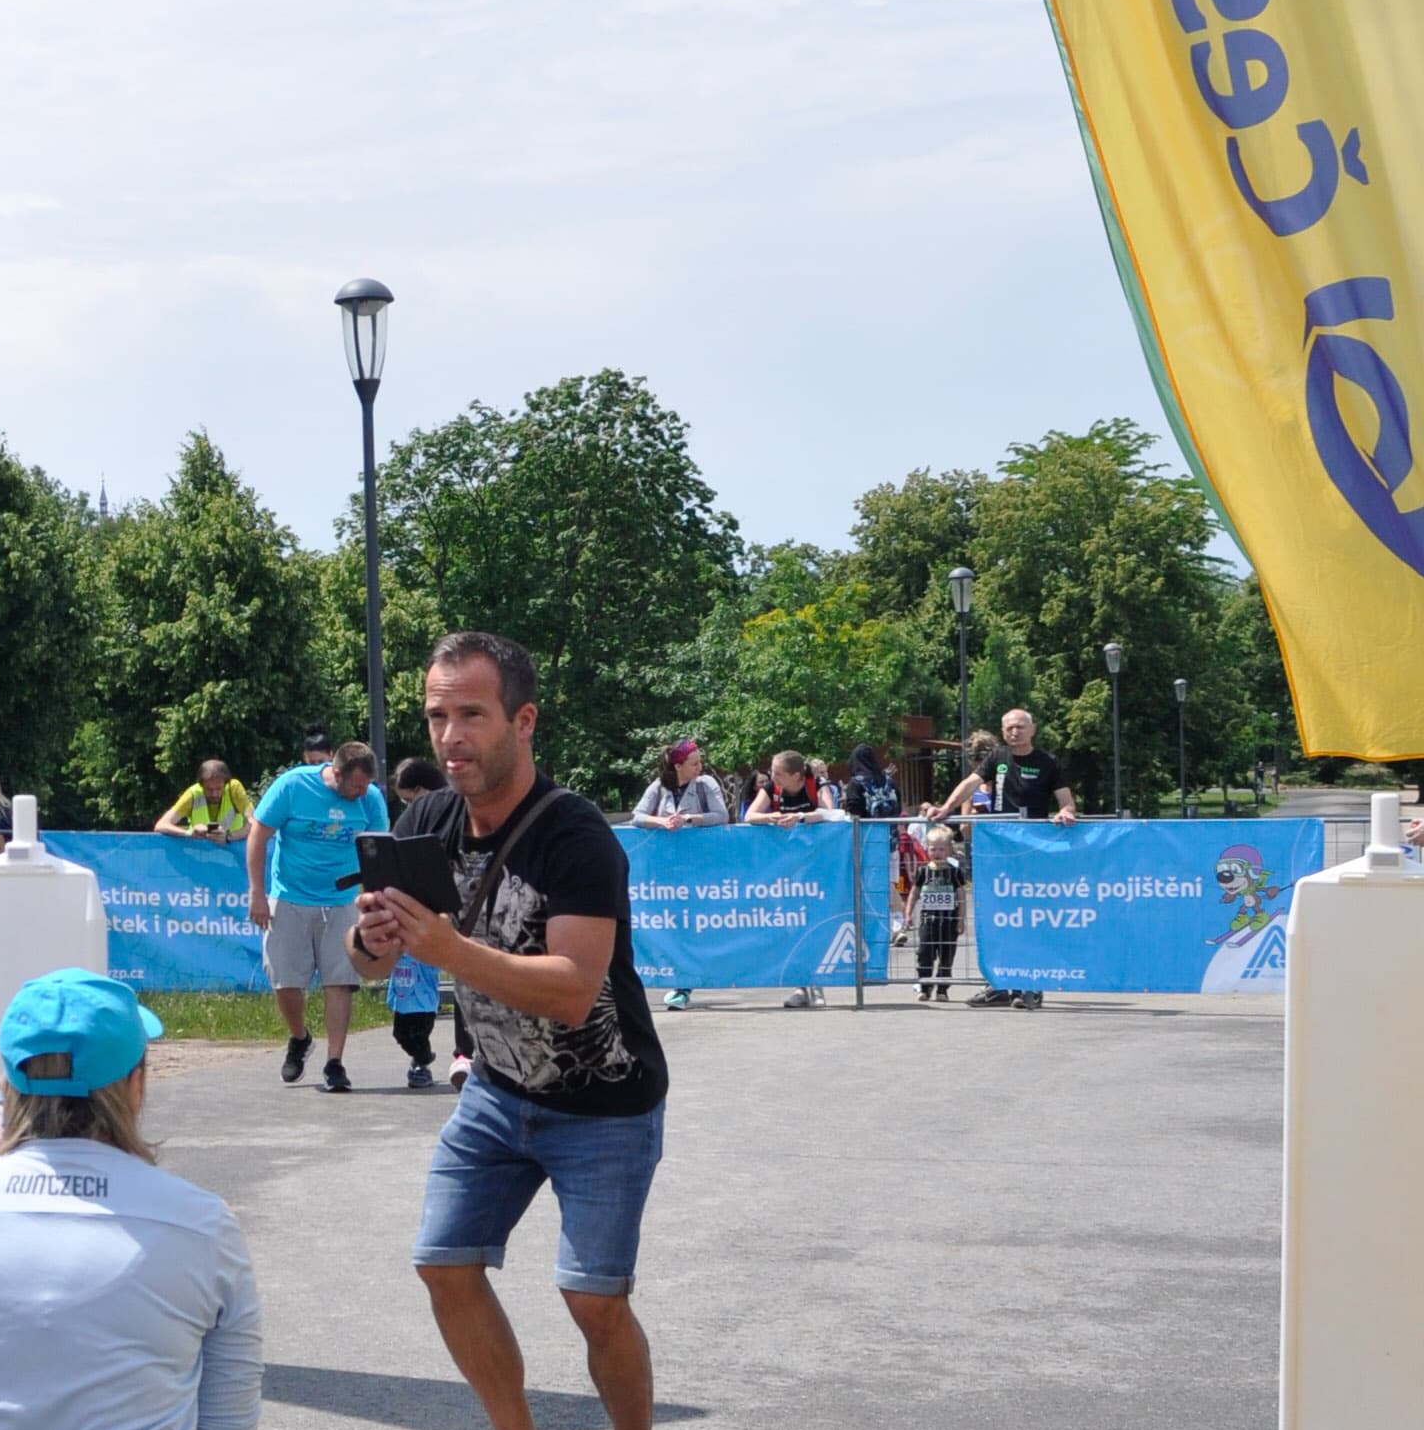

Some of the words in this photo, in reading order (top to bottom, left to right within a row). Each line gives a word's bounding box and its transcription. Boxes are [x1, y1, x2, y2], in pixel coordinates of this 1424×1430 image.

[102, 885, 161, 907] stíme
[167, 886, 210, 908] vaši
[628, 879, 689, 901] stíme
[695, 879, 739, 901] vaši
[745, 877, 825, 901] rodinu,
[993, 872, 1090, 898] Úrazové
[1097, 875, 1203, 903] pojištění
[106, 914, 148, 934] etek
[154, 915, 161, 934] i
[167, 915, 262, 938] podniká
[630, 908, 677, 930] etek
[683, 908, 689, 929] i
[696, 905, 807, 933] podnikání
[993, 907, 1023, 928] od
[1031, 908, 1097, 929] PVZP
[992, 966, 1086, 981] www.pvzp.cz
[6, 1174, 109, 1198] RUNCZECH
